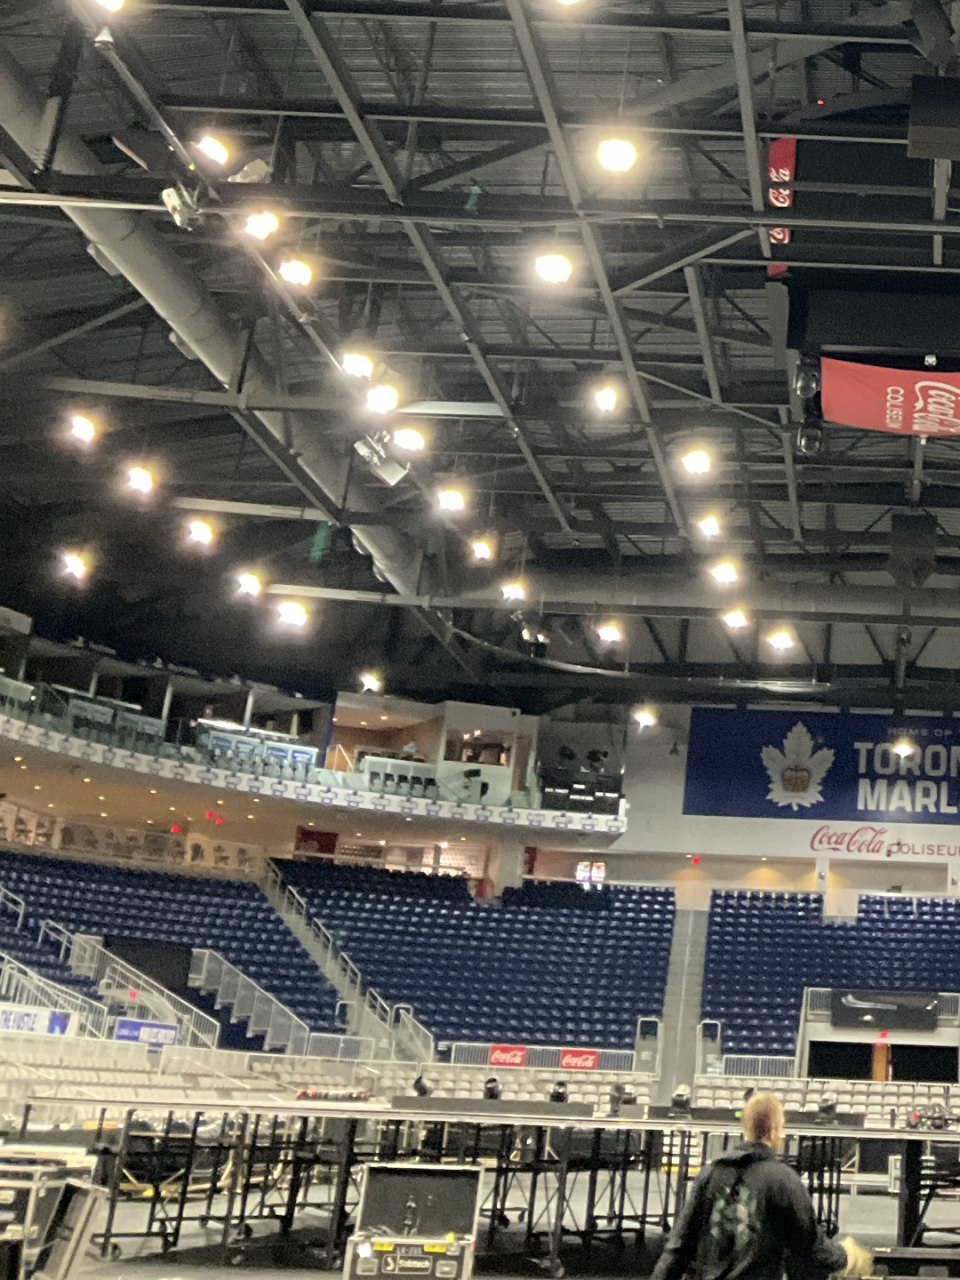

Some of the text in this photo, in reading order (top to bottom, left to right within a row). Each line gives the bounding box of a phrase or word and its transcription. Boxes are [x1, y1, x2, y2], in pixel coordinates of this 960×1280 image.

[886, 386, 904, 429] COLISEUM
[888, 727, 929, 737] HOME
[934, 729, 952, 737] OF
[810, 825, 888, 854] Coca-Cola
